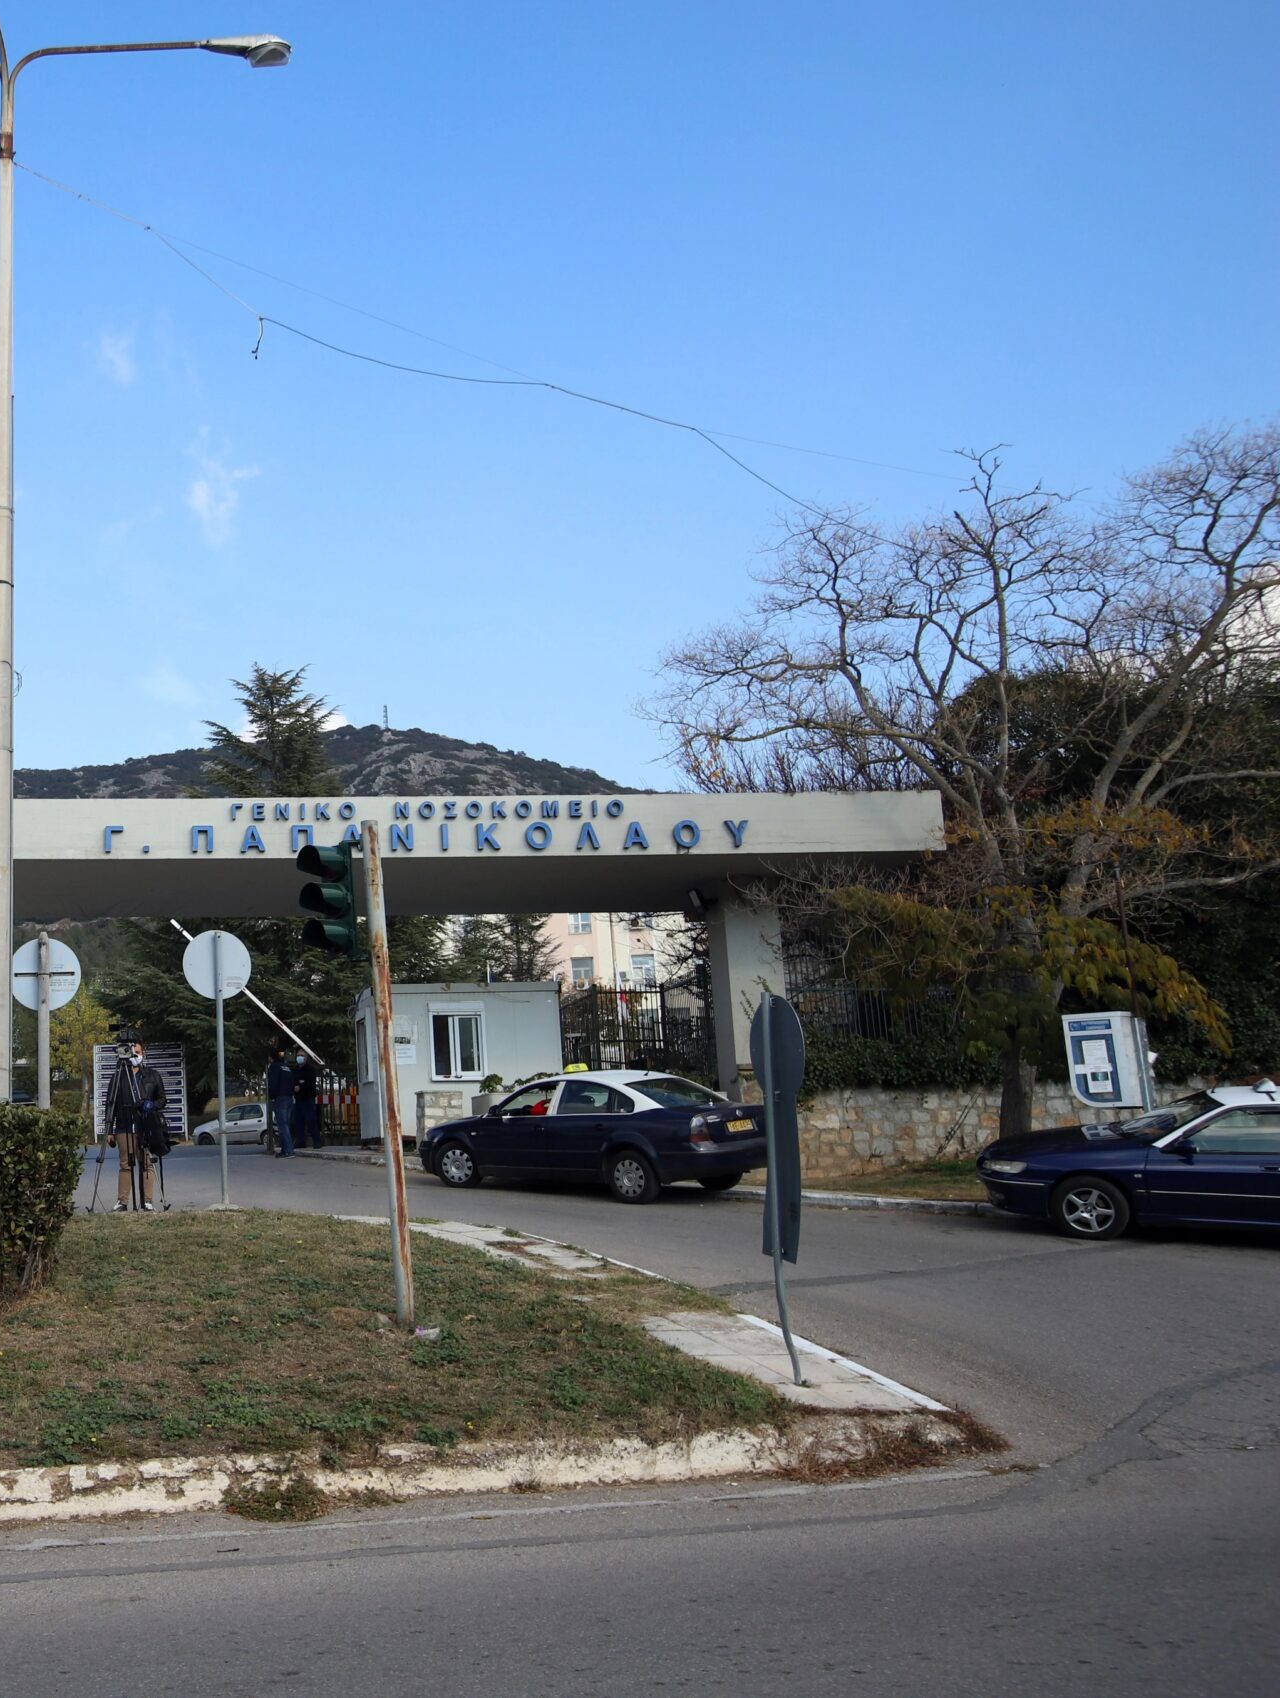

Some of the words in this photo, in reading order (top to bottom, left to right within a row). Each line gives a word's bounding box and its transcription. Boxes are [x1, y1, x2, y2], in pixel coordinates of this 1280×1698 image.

[231, 801, 356, 821] ΓΕΝΙΚΟ
[394, 799, 624, 820] ΝΟΣΟΚΟΜΕΙΟ
[191, 820, 749, 853] ΠΑΠΑΝΙΚΟΛΑΟΥ
